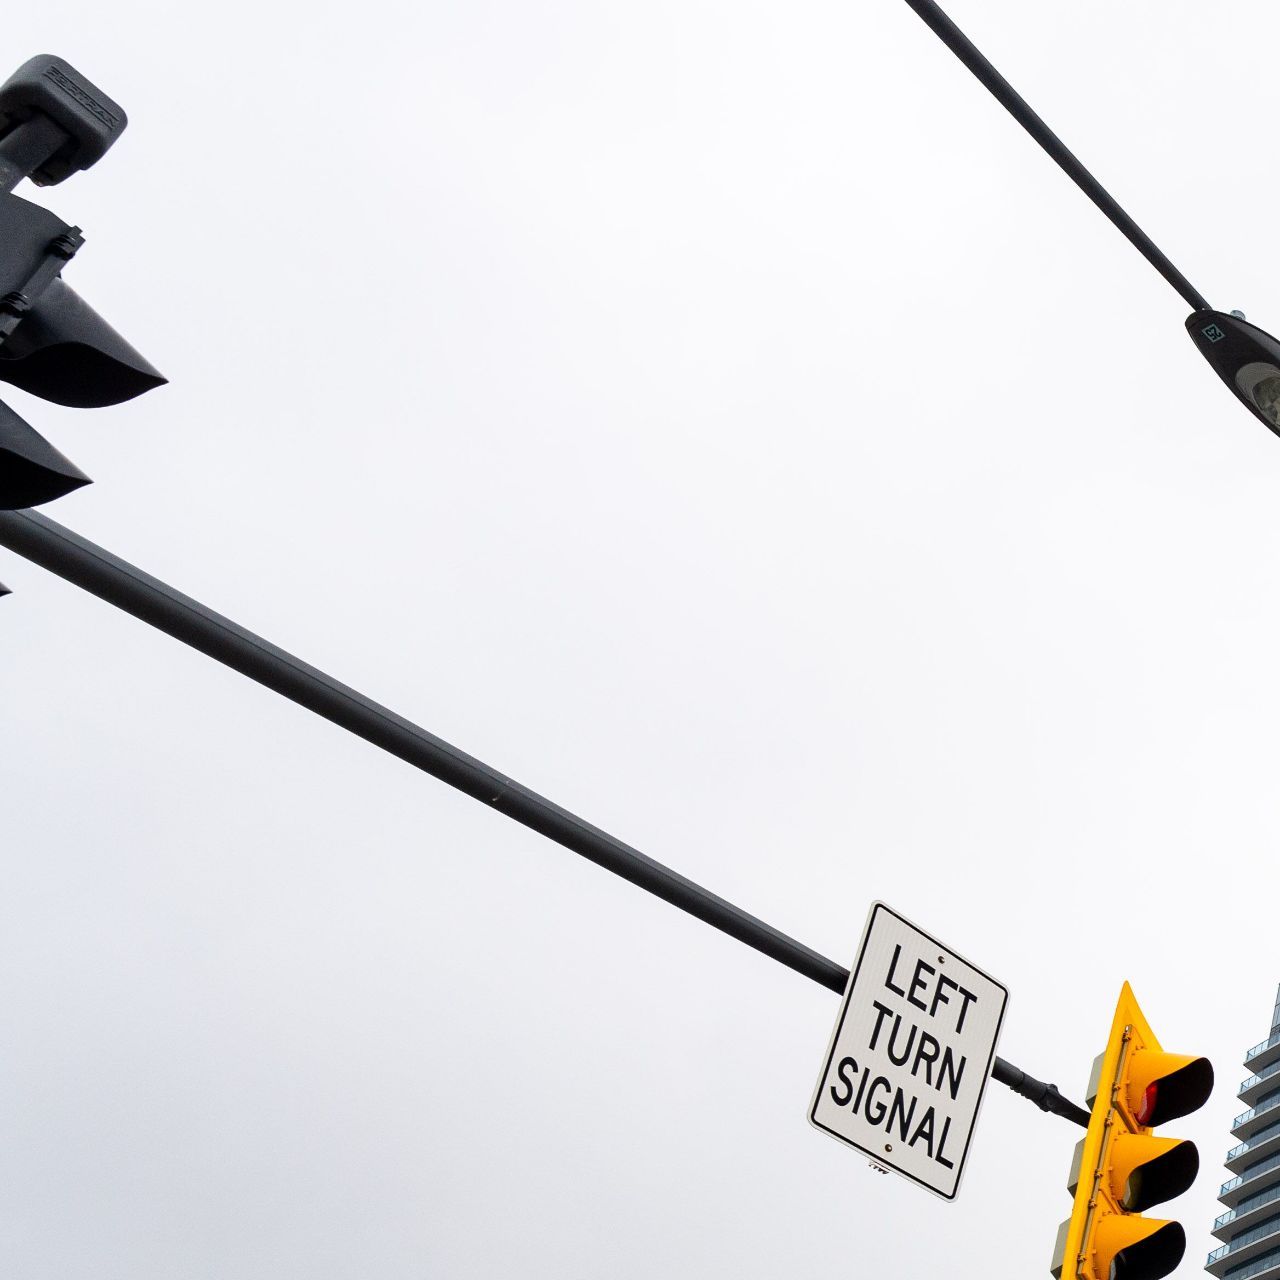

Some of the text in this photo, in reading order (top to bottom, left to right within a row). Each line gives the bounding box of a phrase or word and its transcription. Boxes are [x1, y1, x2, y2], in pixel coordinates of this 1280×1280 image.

[884, 944, 978, 1034] LEFT
[867, 999, 967, 1101] TURN
[830, 1056, 955, 1171] SIGNAL
